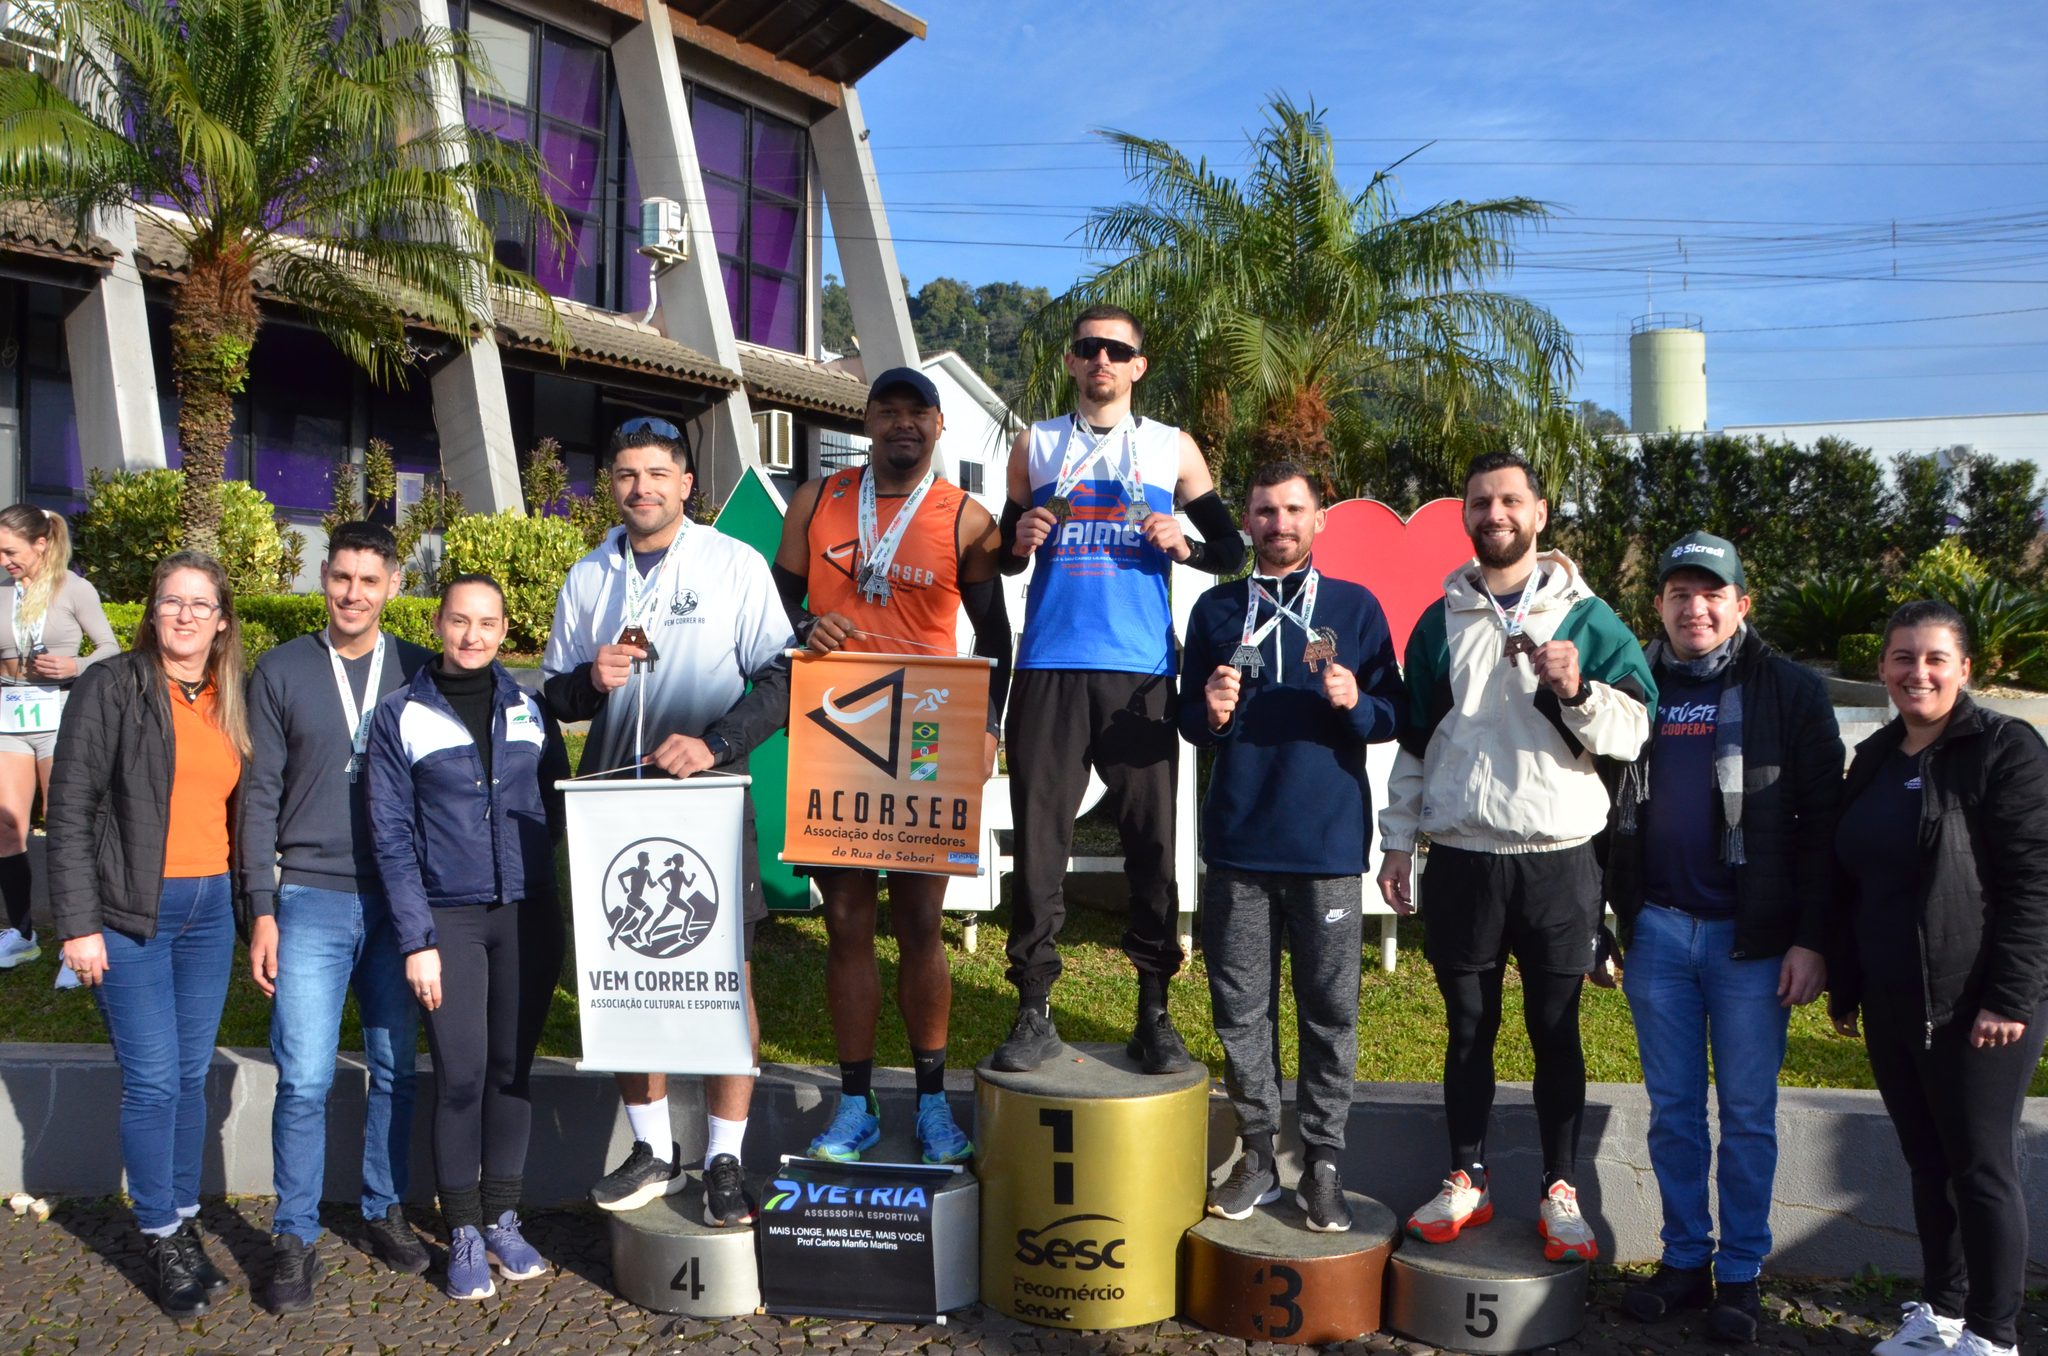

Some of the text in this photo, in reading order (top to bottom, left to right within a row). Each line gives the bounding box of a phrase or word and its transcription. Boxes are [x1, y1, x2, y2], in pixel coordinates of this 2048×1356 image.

[907, 486, 924, 506] CRESOL
[1683, 543, 1725, 558] Sicredi
[675, 617, 697, 625] CORRER
[698, 616, 705, 624] RB
[14, 703, 41, 727] 11
[806, 788, 968, 831] ACORSEB
[803, 824, 966, 848] Associação dos Corredores
[831, 846, 847, 857] de
[850, 848, 873, 860] Rua
[876, 849, 892, 861] de
[895, 851, 935, 864] Seberi
[1327, 908, 1345, 918] NIKE
[588, 970, 740, 993] VEM CORRER RB
[590, 997, 741, 1011] ASSOCIAÇÃO CULTURAL E ESPORTIVA
[1039, 1108, 1074, 1205] 1
[806, 1183, 927, 1208] VETRIA
[804, 1209, 920, 1222] ASSESSORIA ESPORTIVA
[769, 1226, 925, 1242] MAIS LONGE, MAIS LEVE, MAIS VOCÊ!
[797, 1237, 898, 1250] Prof Carlos Manfio Martins
[670, 1257, 705, 1300] 4
[1014, 1276, 1125, 1301] Fecomércio
[1014, 1299, 1071, 1322] Senac
[1252, 1264, 1304, 1338] 3
[1465, 1292, 1499, 1338] 5
